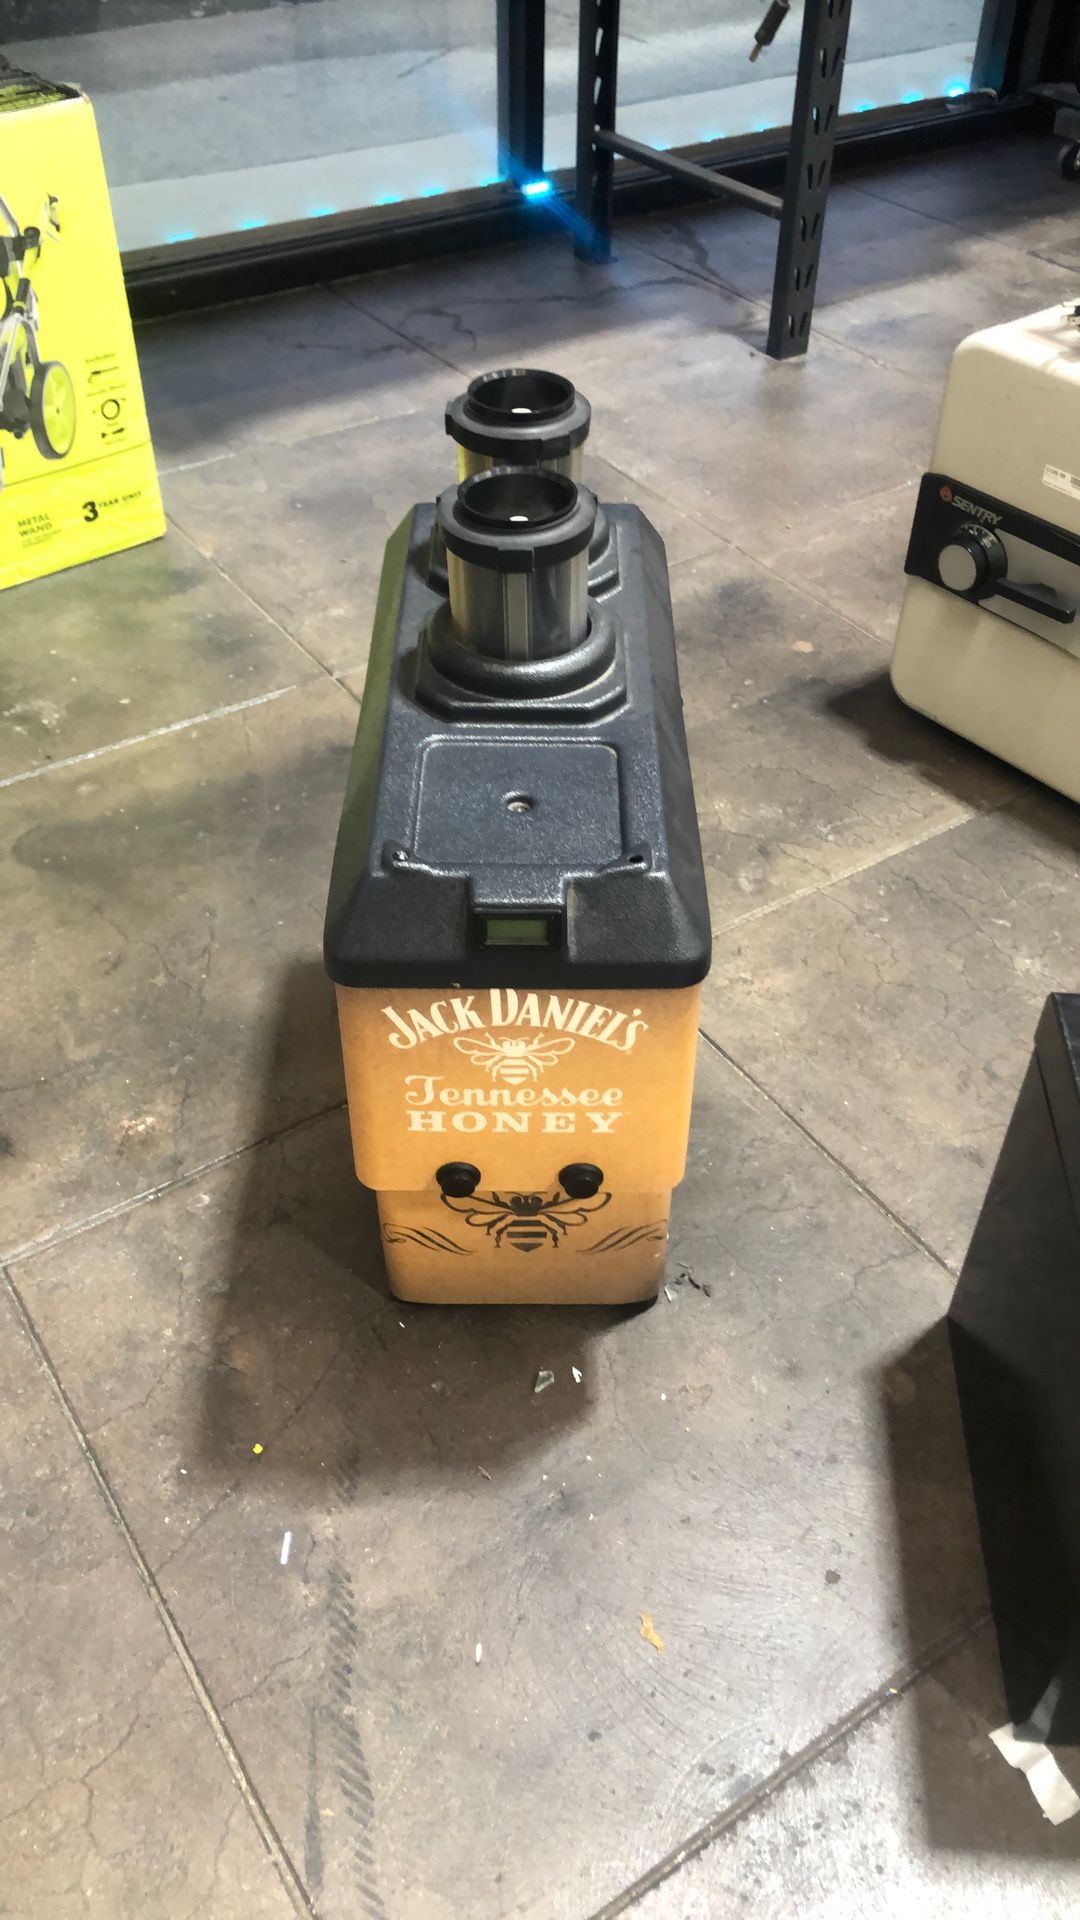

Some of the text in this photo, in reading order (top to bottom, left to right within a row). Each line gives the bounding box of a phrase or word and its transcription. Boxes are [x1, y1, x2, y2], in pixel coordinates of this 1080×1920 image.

[17, 513, 50, 527] METAL
[82, 501, 99, 522] 3
[98, 498, 119, 508] YEAR
[952, 495, 1002, 525] SENTRY
[19, 522, 53, 536] WAND
[381, 988, 649, 1051] JACK DANIEL'S
[404, 1074, 623, 1107] Tennessee
[405, 1110, 623, 1135] HONEY
